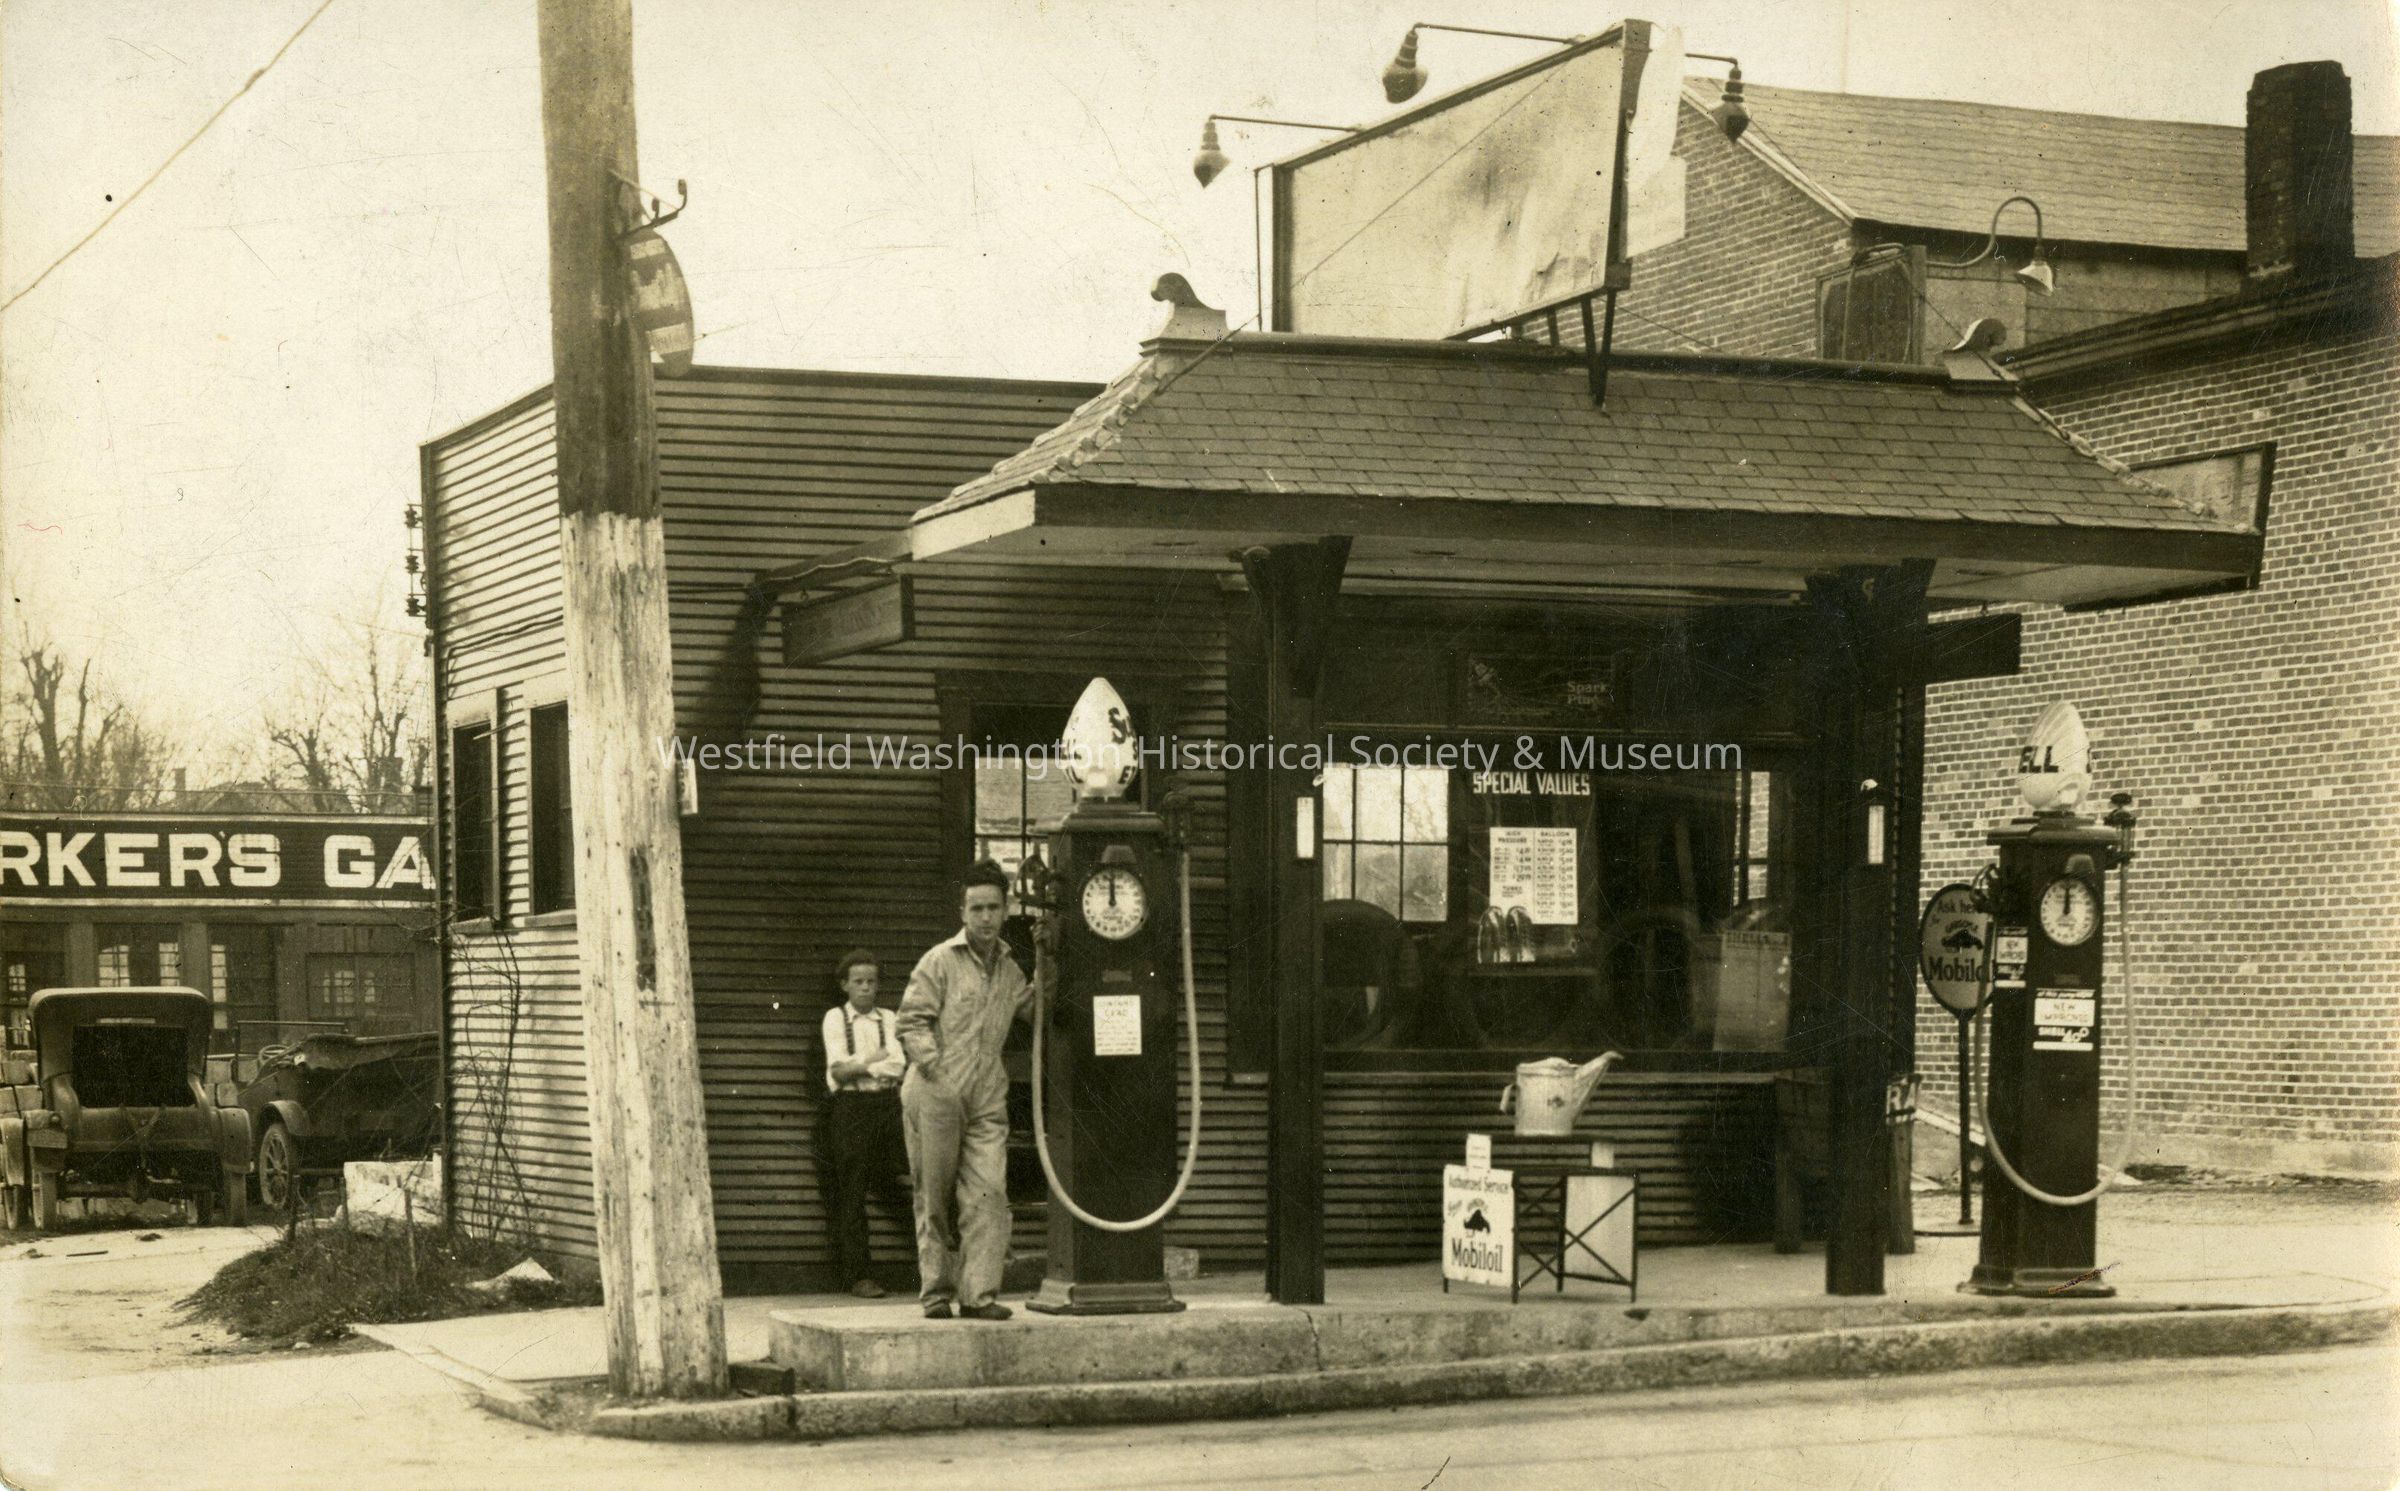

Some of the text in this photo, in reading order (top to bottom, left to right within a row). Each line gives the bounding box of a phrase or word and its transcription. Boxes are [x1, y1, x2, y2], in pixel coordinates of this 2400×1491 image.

[1473, 771, 1590, 796] SPECIAL VALUES
[0, 830, 437, 889] RKER'S GA
[1937, 899, 1956, 913] Ask
[1928, 956, 1986, 982] Mobilo
[1484, 1177, 1509, 1194] Service
[1452, 1238, 1503, 1273] Mobiloil
